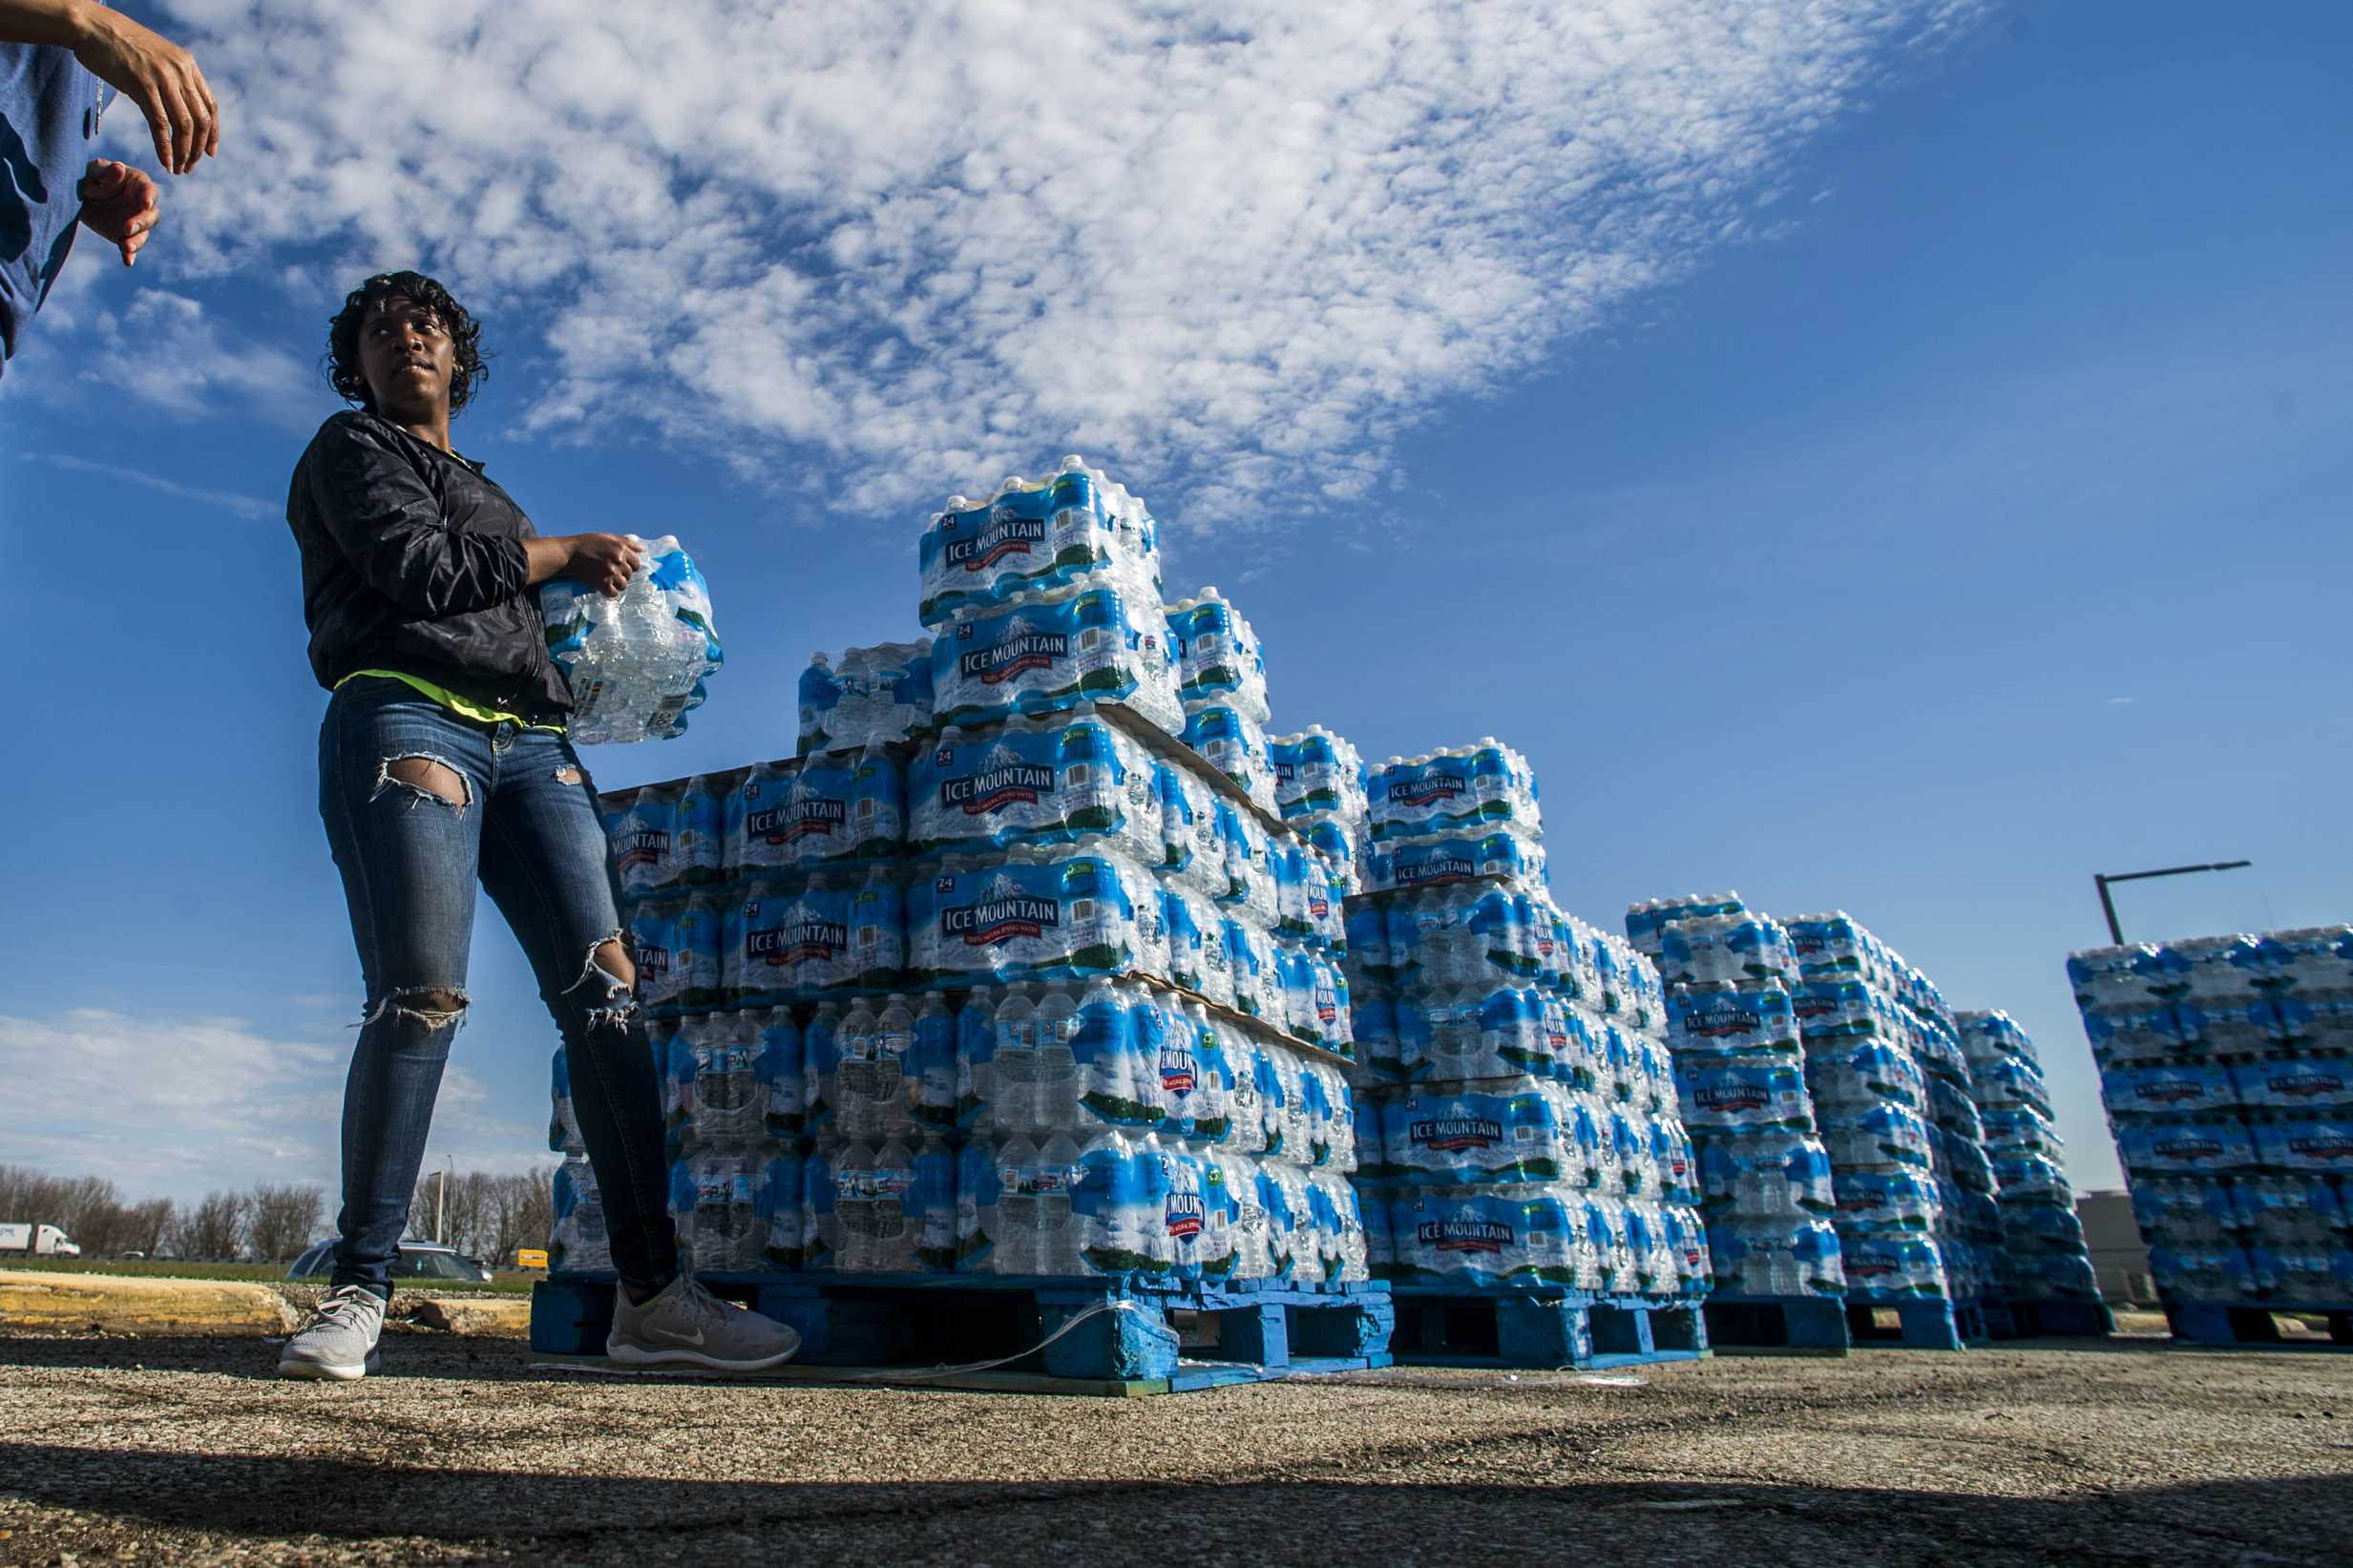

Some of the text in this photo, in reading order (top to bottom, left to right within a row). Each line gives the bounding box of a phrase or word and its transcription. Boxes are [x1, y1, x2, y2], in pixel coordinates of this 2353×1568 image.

[942, 516, 955, 527] 24
[949, 542, 973, 561] ICE
[976, 522, 1042, 554] MOUNTAIN
[957, 624, 971, 635] 24
[964, 652, 989, 673] ICE
[992, 637, 1064, 665] MOUNTAIN
[936, 750, 952, 762] 24
[745, 784, 758, 796] 24
[945, 767, 1050, 802] ICE MOUNTAIN
[1391, 785, 1408, 798] ICE
[1410, 777, 1463, 795] MOUNTAIN
[998, 791, 1016, 801] SPRING
[750, 813, 774, 833] ICE
[776, 802, 842, 826] MOUNTAIN
[1398, 867, 1416, 880] ICE
[1418, 860, 1471, 877] MOUNTAIN
[937, 877, 953, 889] 24
[745, 903, 758, 913] 24
[946, 900, 1054, 930] ICE MOUNTAIN
[750, 925, 844, 952] ICE MOUNTAIN
[983, 930, 1001, 941] NATURAL
[1000, 925, 1019, 934] SPRING
[1019, 925, 1038, 934] WATER
[1688, 1013, 1758, 1028] ICE MOUNTAIN
[1696, 1088, 1769, 1103] ICE MOUNTAIN
[1413, 1120, 1500, 1139] ICE MOUNTAIN
[1420, 1223, 1511, 1241] ICE MOUNTAIN
